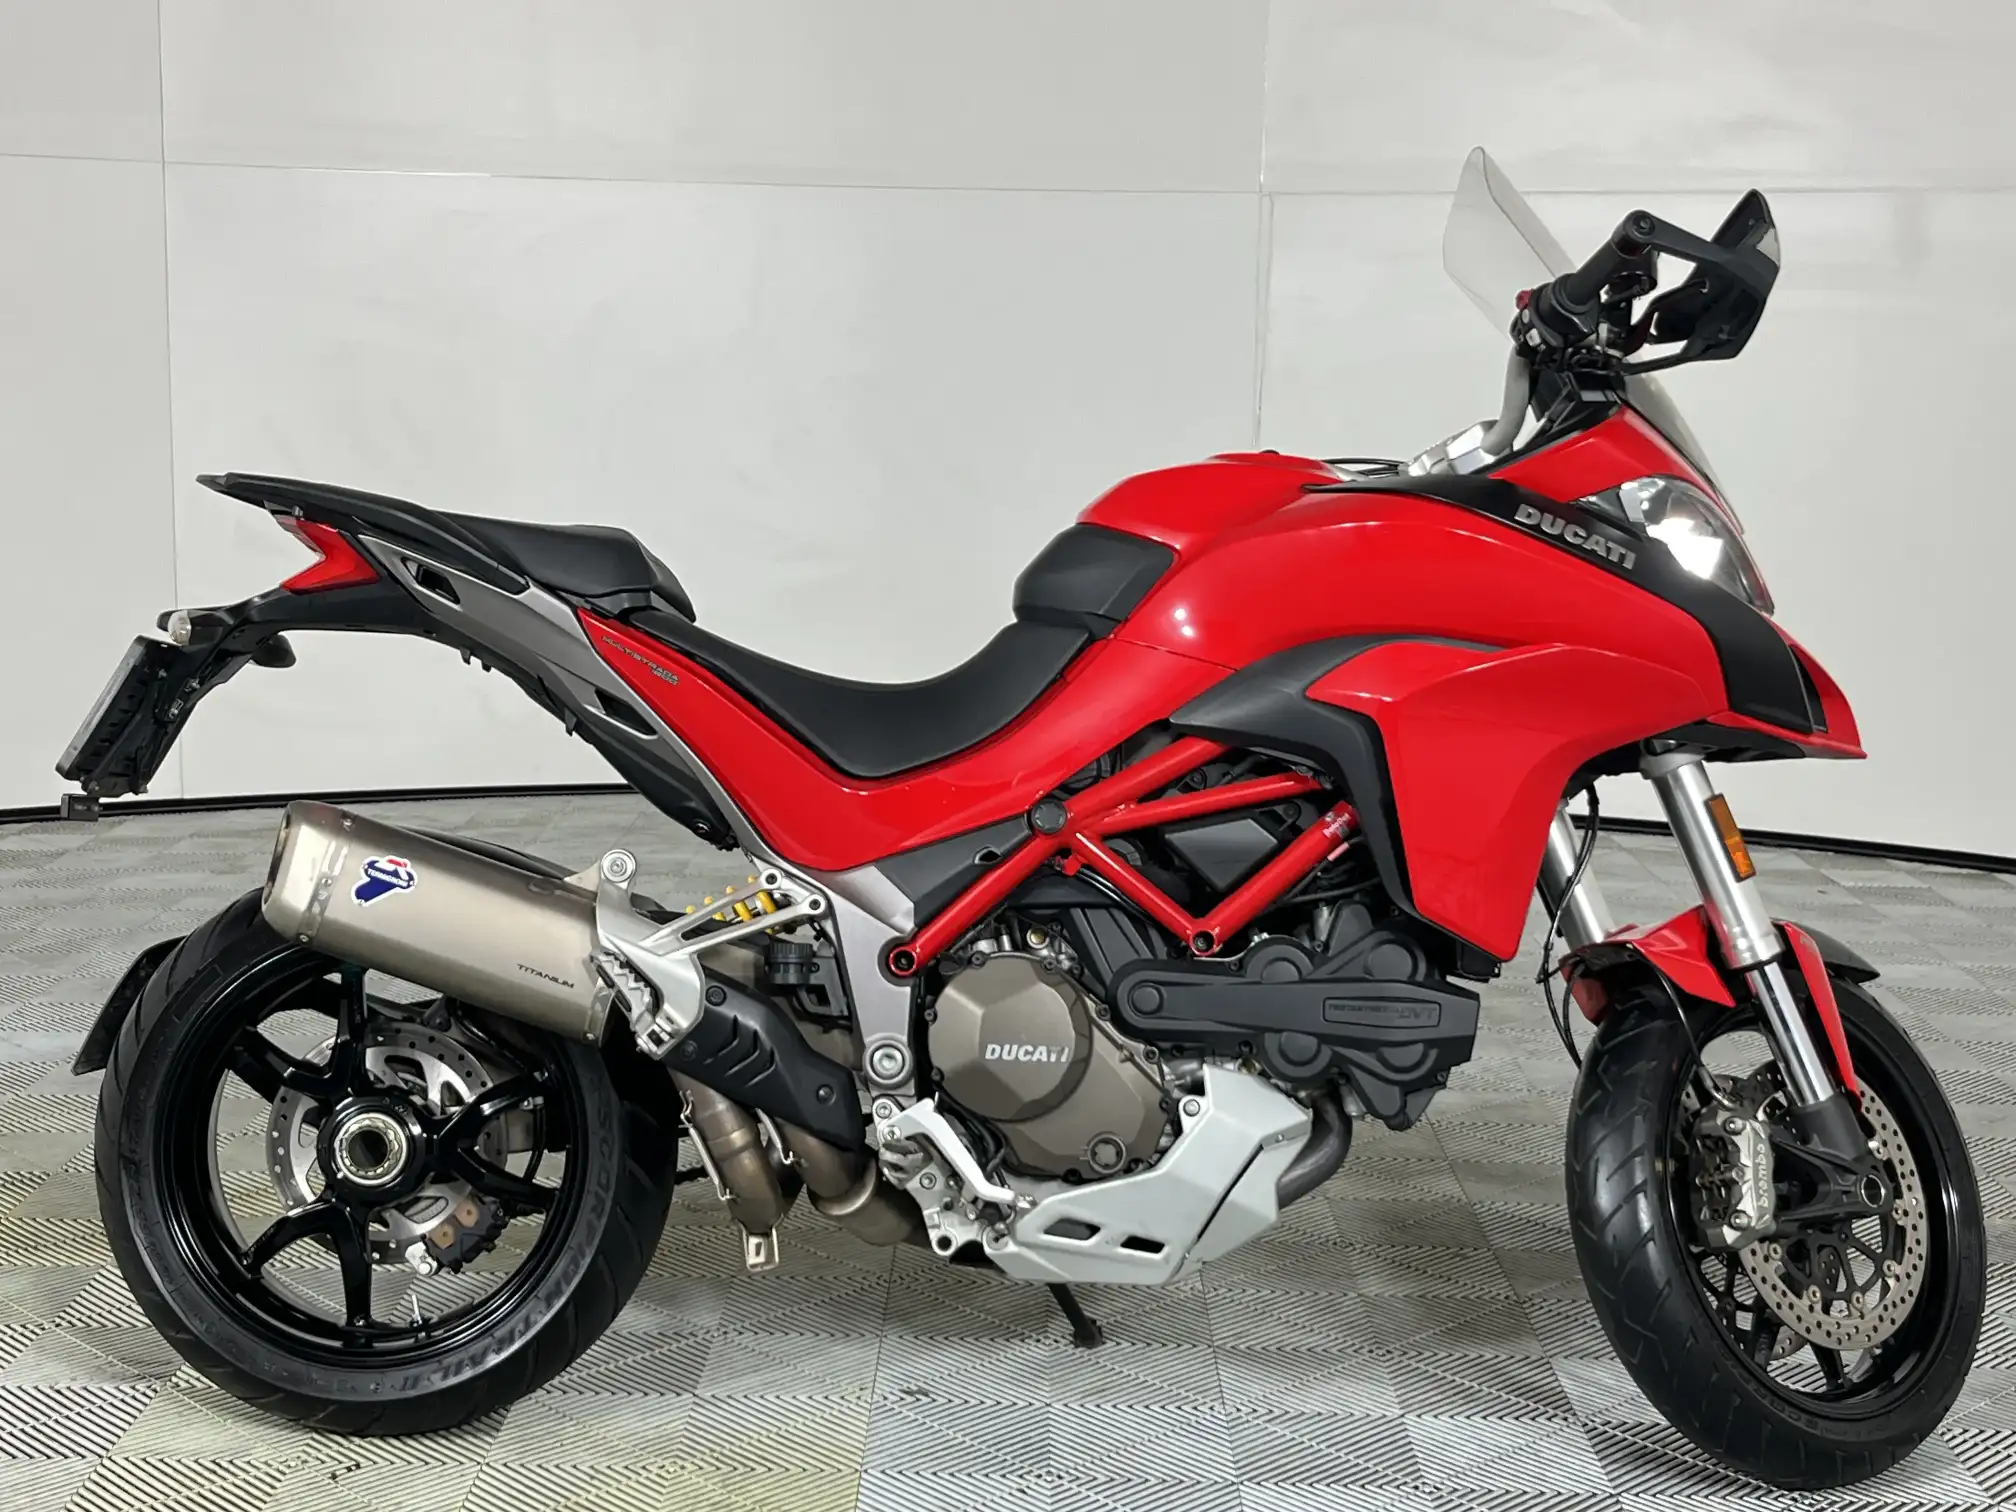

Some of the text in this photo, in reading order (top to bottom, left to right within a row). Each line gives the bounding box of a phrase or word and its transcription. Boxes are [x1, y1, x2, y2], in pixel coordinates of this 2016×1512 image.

[1513, 503, 1637, 570] DUCATI
[517, 963, 575, 988] TITANIUM
[984, 1043, 1069, 1063] DUCATI
[1754, 1142, 1769, 1208] brembo
